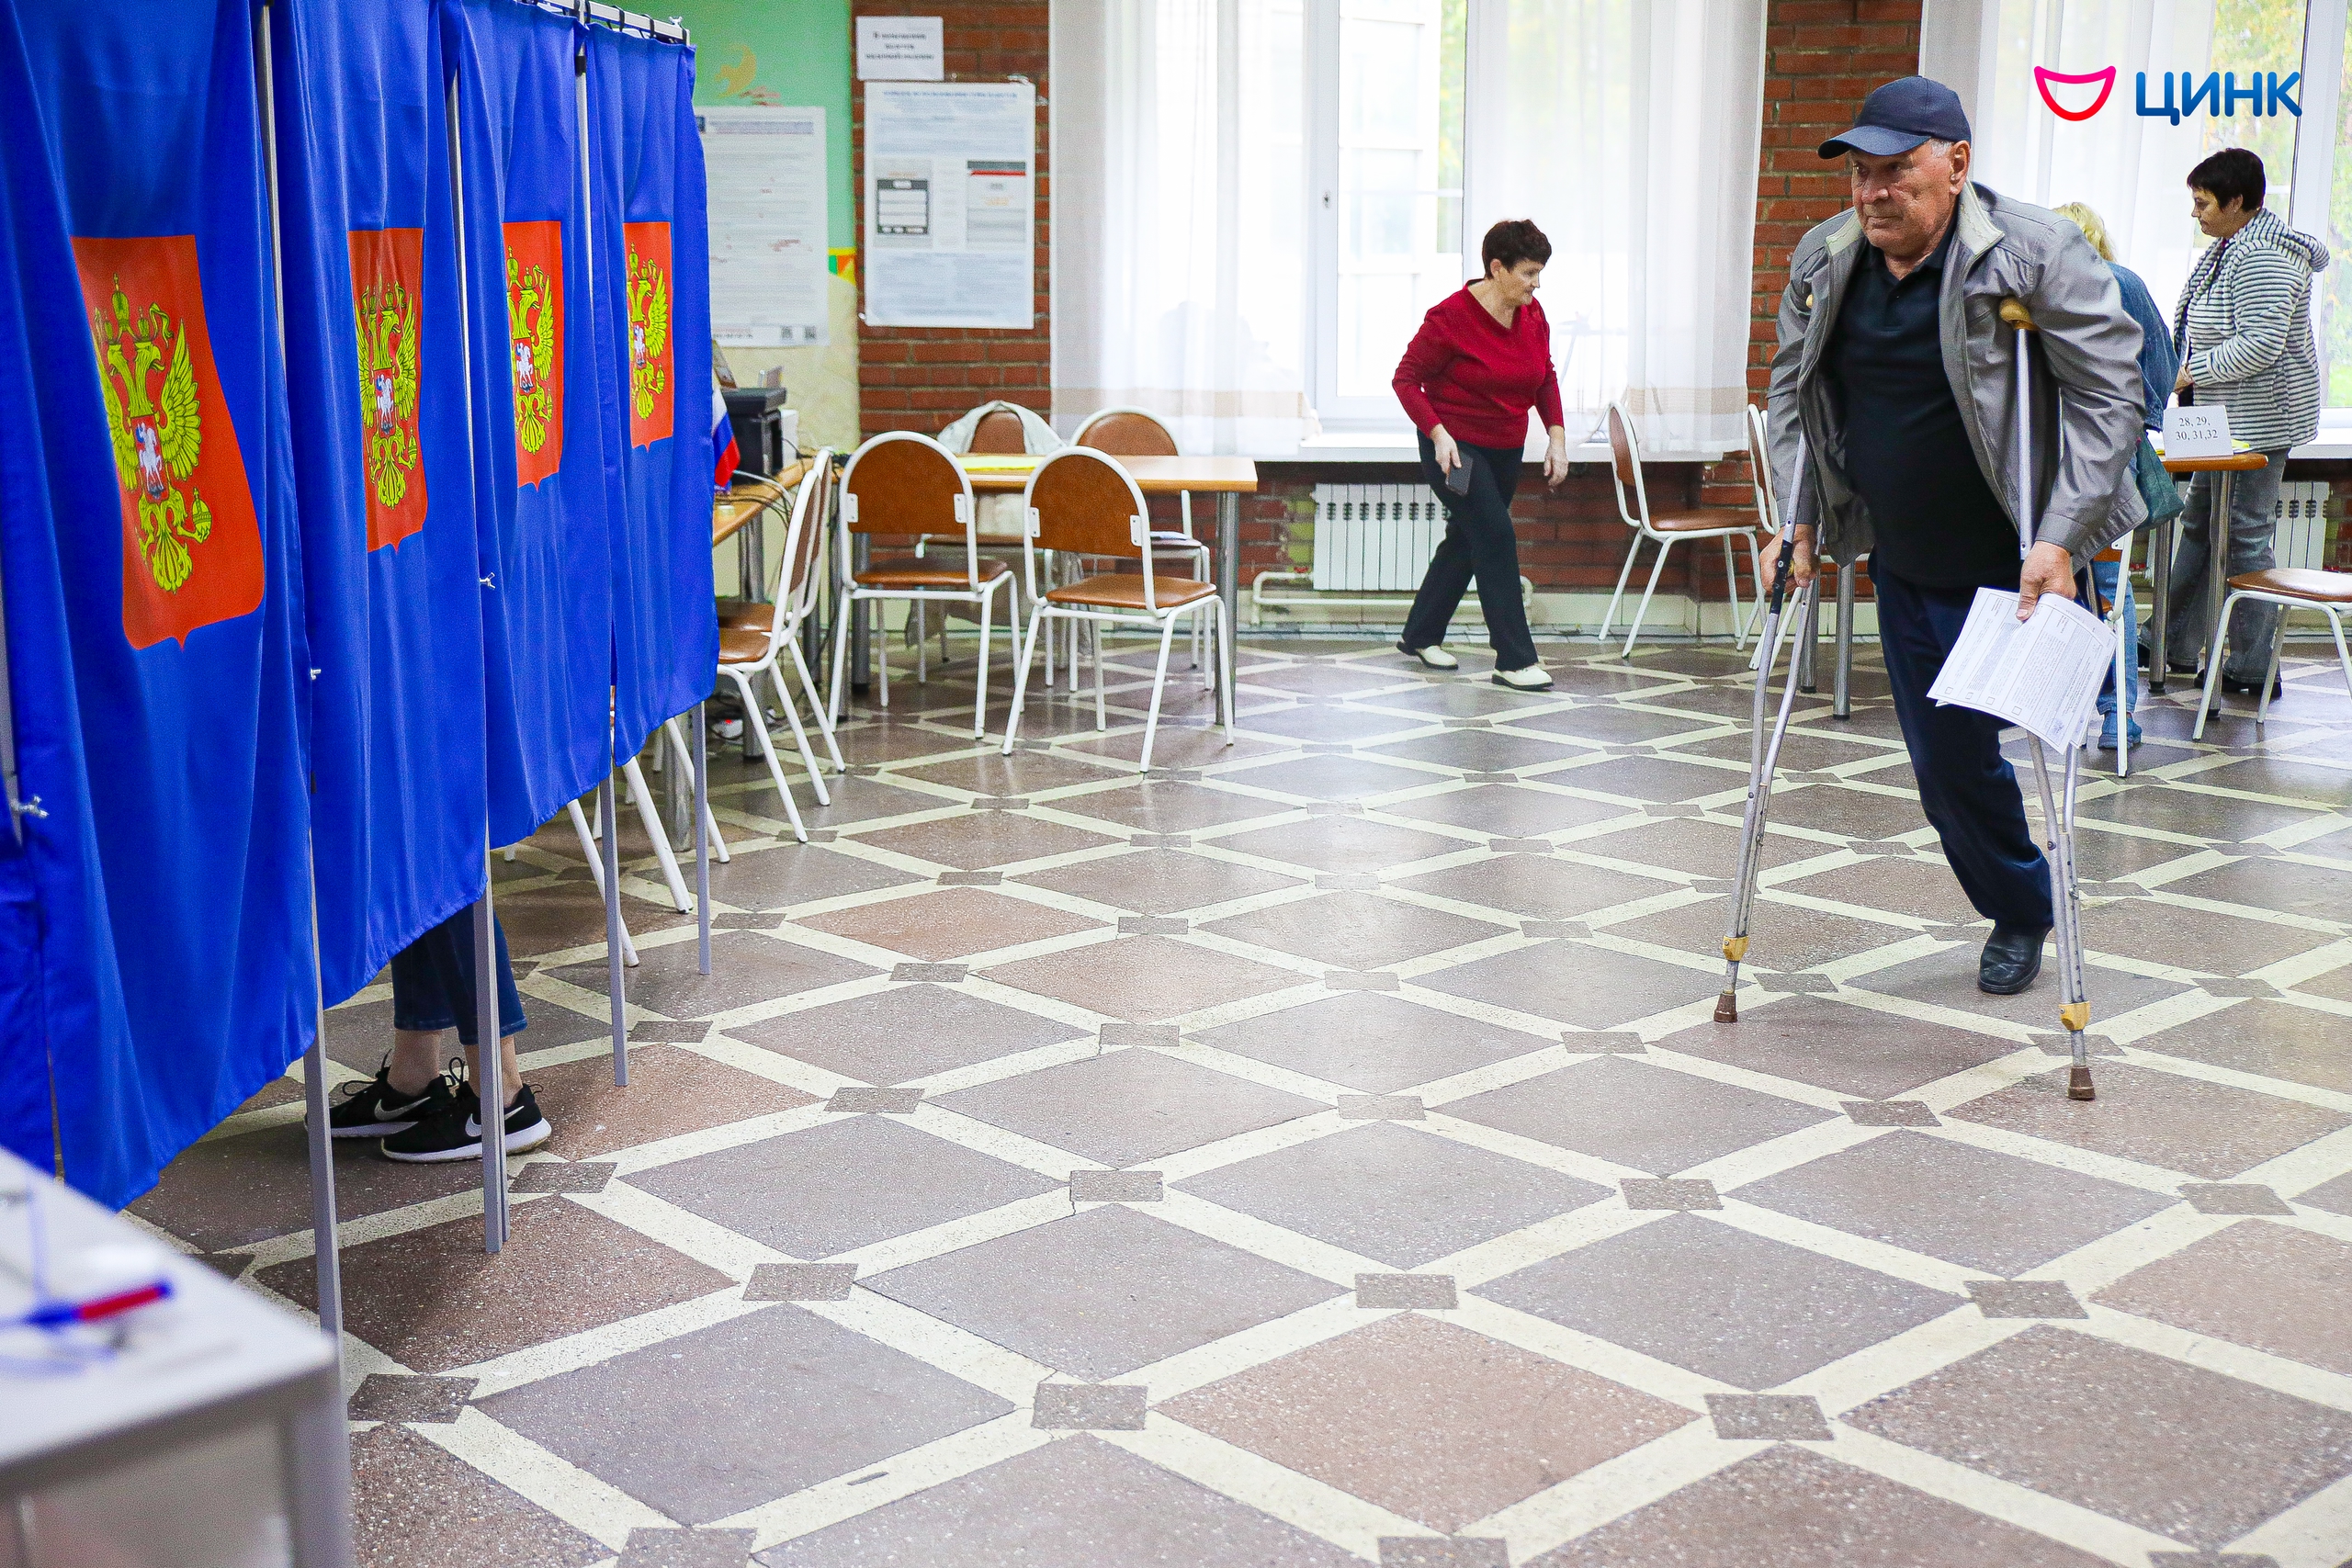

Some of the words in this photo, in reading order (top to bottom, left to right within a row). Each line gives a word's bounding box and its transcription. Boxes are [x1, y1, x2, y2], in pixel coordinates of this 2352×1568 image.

[2179, 417, 2194, 427] 28,
[2197, 416, 2211, 426] 29,
[2176, 431, 2190, 441] 30,
